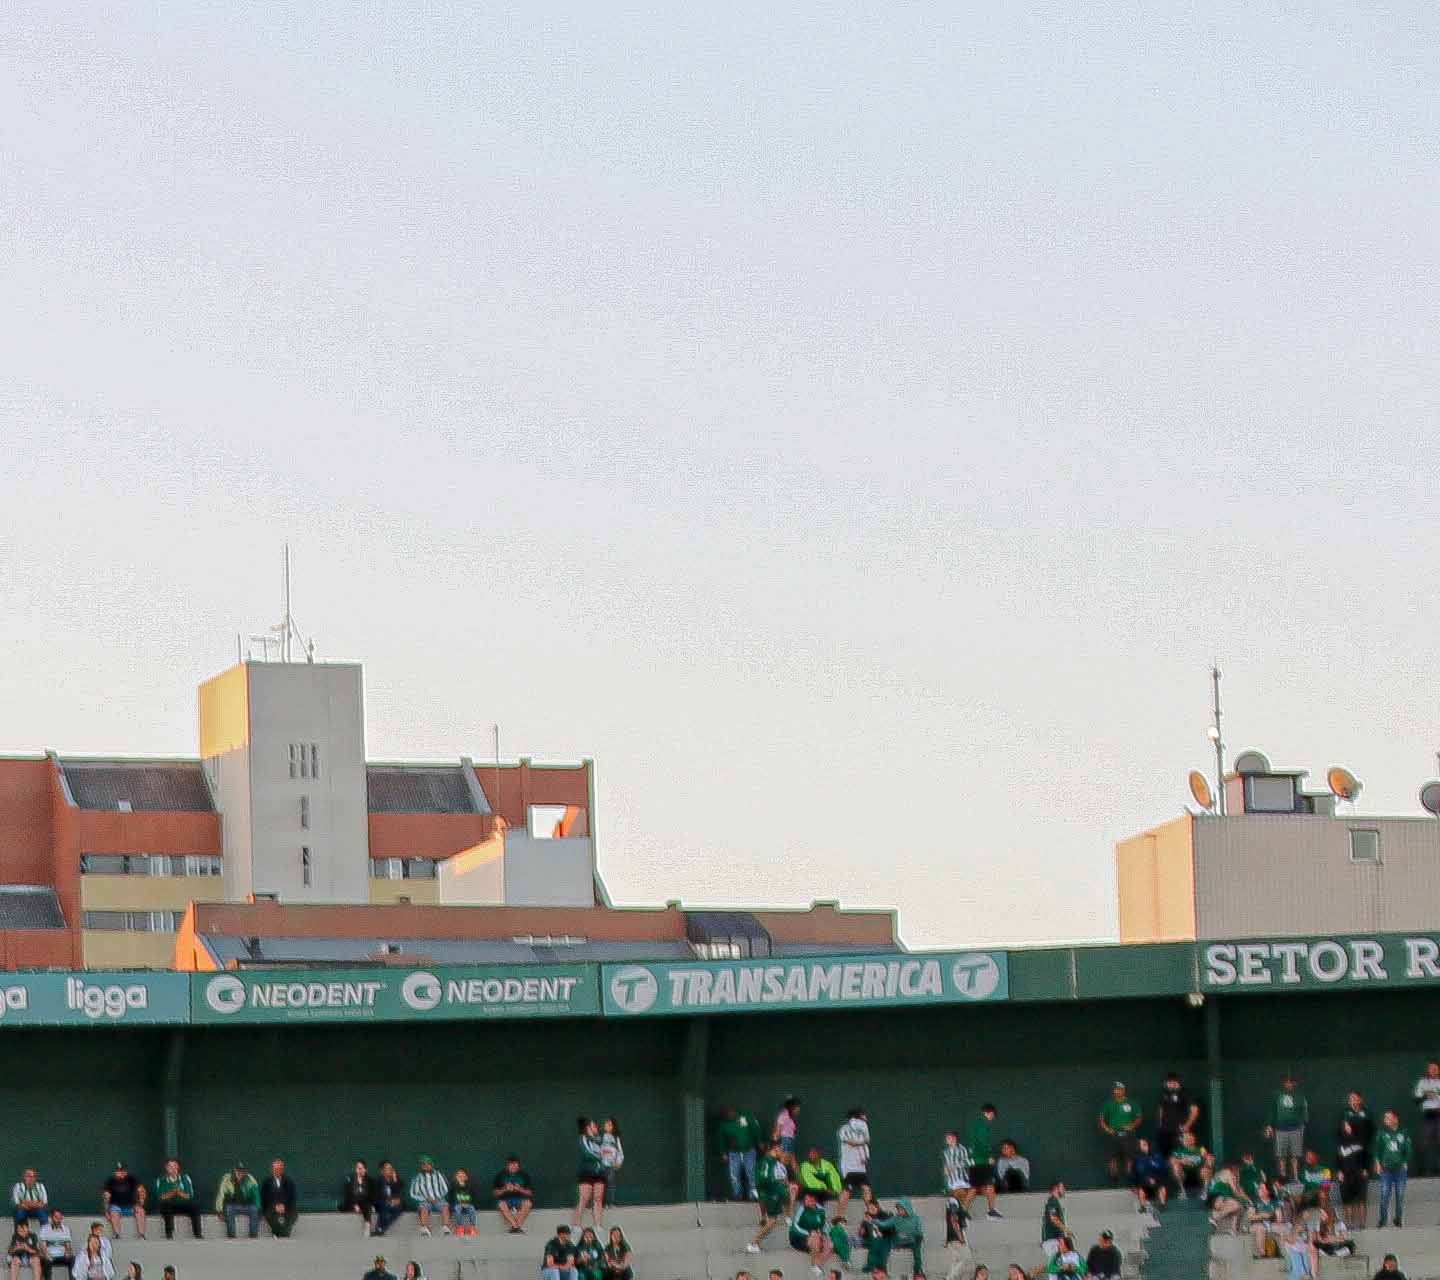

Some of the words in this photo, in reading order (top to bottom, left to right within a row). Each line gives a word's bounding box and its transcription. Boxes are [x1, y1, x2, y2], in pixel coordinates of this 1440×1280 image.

[668, 959, 943, 1006] TRANSAMERICA
[1205, 941, 1389, 987] SETOR
[64, 977, 148, 1019] ligga
[251, 981, 382, 1007] NEODENT
[447, 977, 577, 1004] NEODENT
